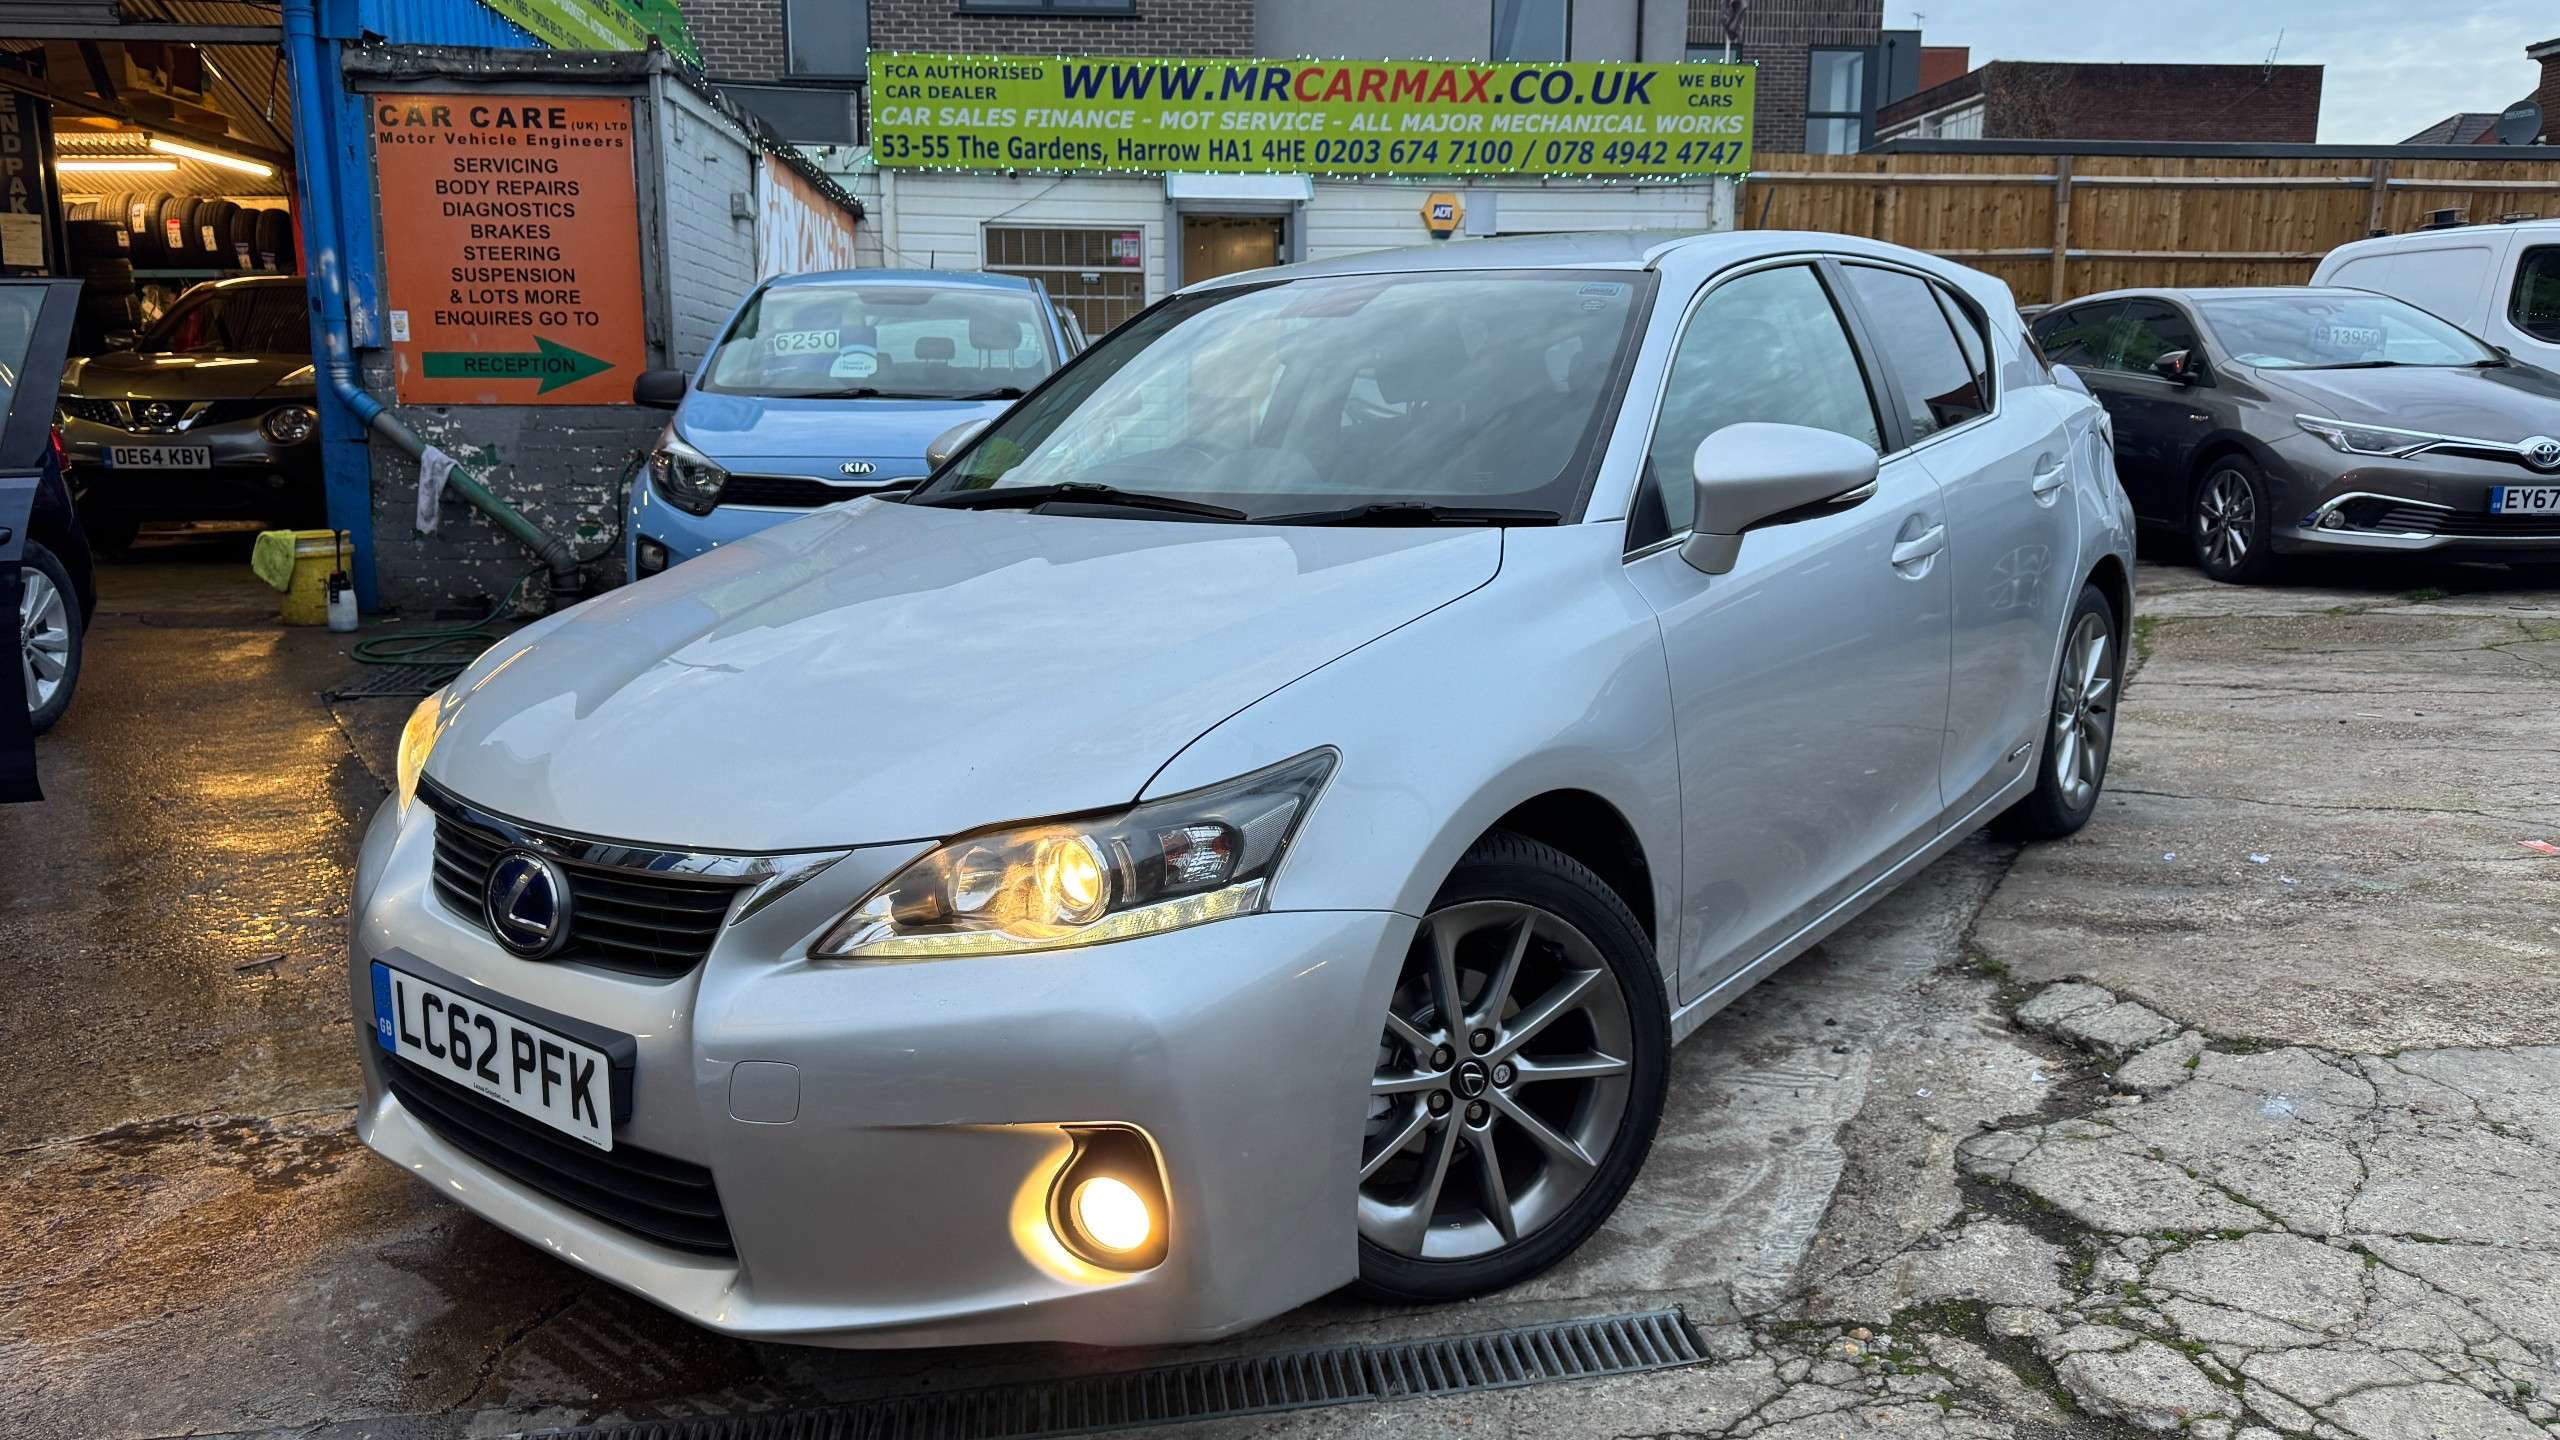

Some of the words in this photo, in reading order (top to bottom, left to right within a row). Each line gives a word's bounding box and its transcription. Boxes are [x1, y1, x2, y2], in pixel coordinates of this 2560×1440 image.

[885, 65, 918, 80] FCA
[925, 65, 1044, 81] AUTHORISED
[1678, 74, 1704, 88] WE
[1710, 75, 1745, 88] BUY
[886, 85, 921, 99] CAR
[928, 86, 997, 100] DEALER
[1062, 64, 1659, 105] WWW.MRCARMAX.CO.UK
[1687, 94, 1733, 107] CARS
[379, 105, 452, 128] CAR
[469, 106, 567, 130] CARE
[571, 121, 599, 132] (UK)
[604, 122, 628, 131] LTD
[881, 106, 930, 126] CAR
[938, 107, 1016, 127] SALES
[1024, 109, 1135, 129] FINANCE
[1160, 110, 1214, 130] MOT
[1219, 112, 1326, 132] SERVICE
[1349, 113, 1393, 132] ALL
[1399, 113, 1482, 133] MAJOR
[1490, 114, 1647, 133] MECHANICAL
[1656, 115, 1744, 134] WORKS
[380, 131, 436, 145] Motor
[444, 132, 517, 146] Vehicle
[526, 134, 624, 149] Engineers
[882, 134, 950, 158] 53-55
[957, 136, 999, 159] The
[1007, 136, 1109, 164] Gardens,
[1118, 138, 1200, 161] Harrow
[1209, 139, 1252, 162] HA1
[1262, 139, 1305, 163] 4HE
[1314, 139, 1380, 164] 0203
[1389, 140, 1437, 164] 674
[1448, 140, 1513, 165] 7100
[1545, 141, 1593, 165] 078
[1602, 141, 1667, 165] 4942
[1676, 141, 1743, 165] 4747
[453, 158, 558, 174] SERVICING
[435, 180, 488, 195] BODY
[497, 180, 579, 196] REPAIRS
[443, 202, 575, 218] DIAGNOSTICS
[1433, 206, 1452, 218] ADT
[471, 224, 550, 239] BRAKES
[463, 246, 561, 261] STEERING
[451, 268, 576, 283] SUSPENSION
[450, 289, 462, 304] &
[469, 289, 519, 305] LOTS
[525, 290, 581, 305] MORE
[434, 311, 533, 326] ENQUIRES
[539, 311, 568, 326] GO
[574, 311, 600, 326] TO
[776, 331, 837, 351] 6250
[463, 357, 576, 373] RECEPTION
[115, 448, 163, 465] OE64
[168, 448, 205, 465] KBV
[845, 462, 870, 473] KIA
[2505, 489, 2560, 509] EY67
[380, 1017, 392, 1036] GB
[396, 980, 500, 1085] LC62
[511, 1026, 599, 1129] PFK
